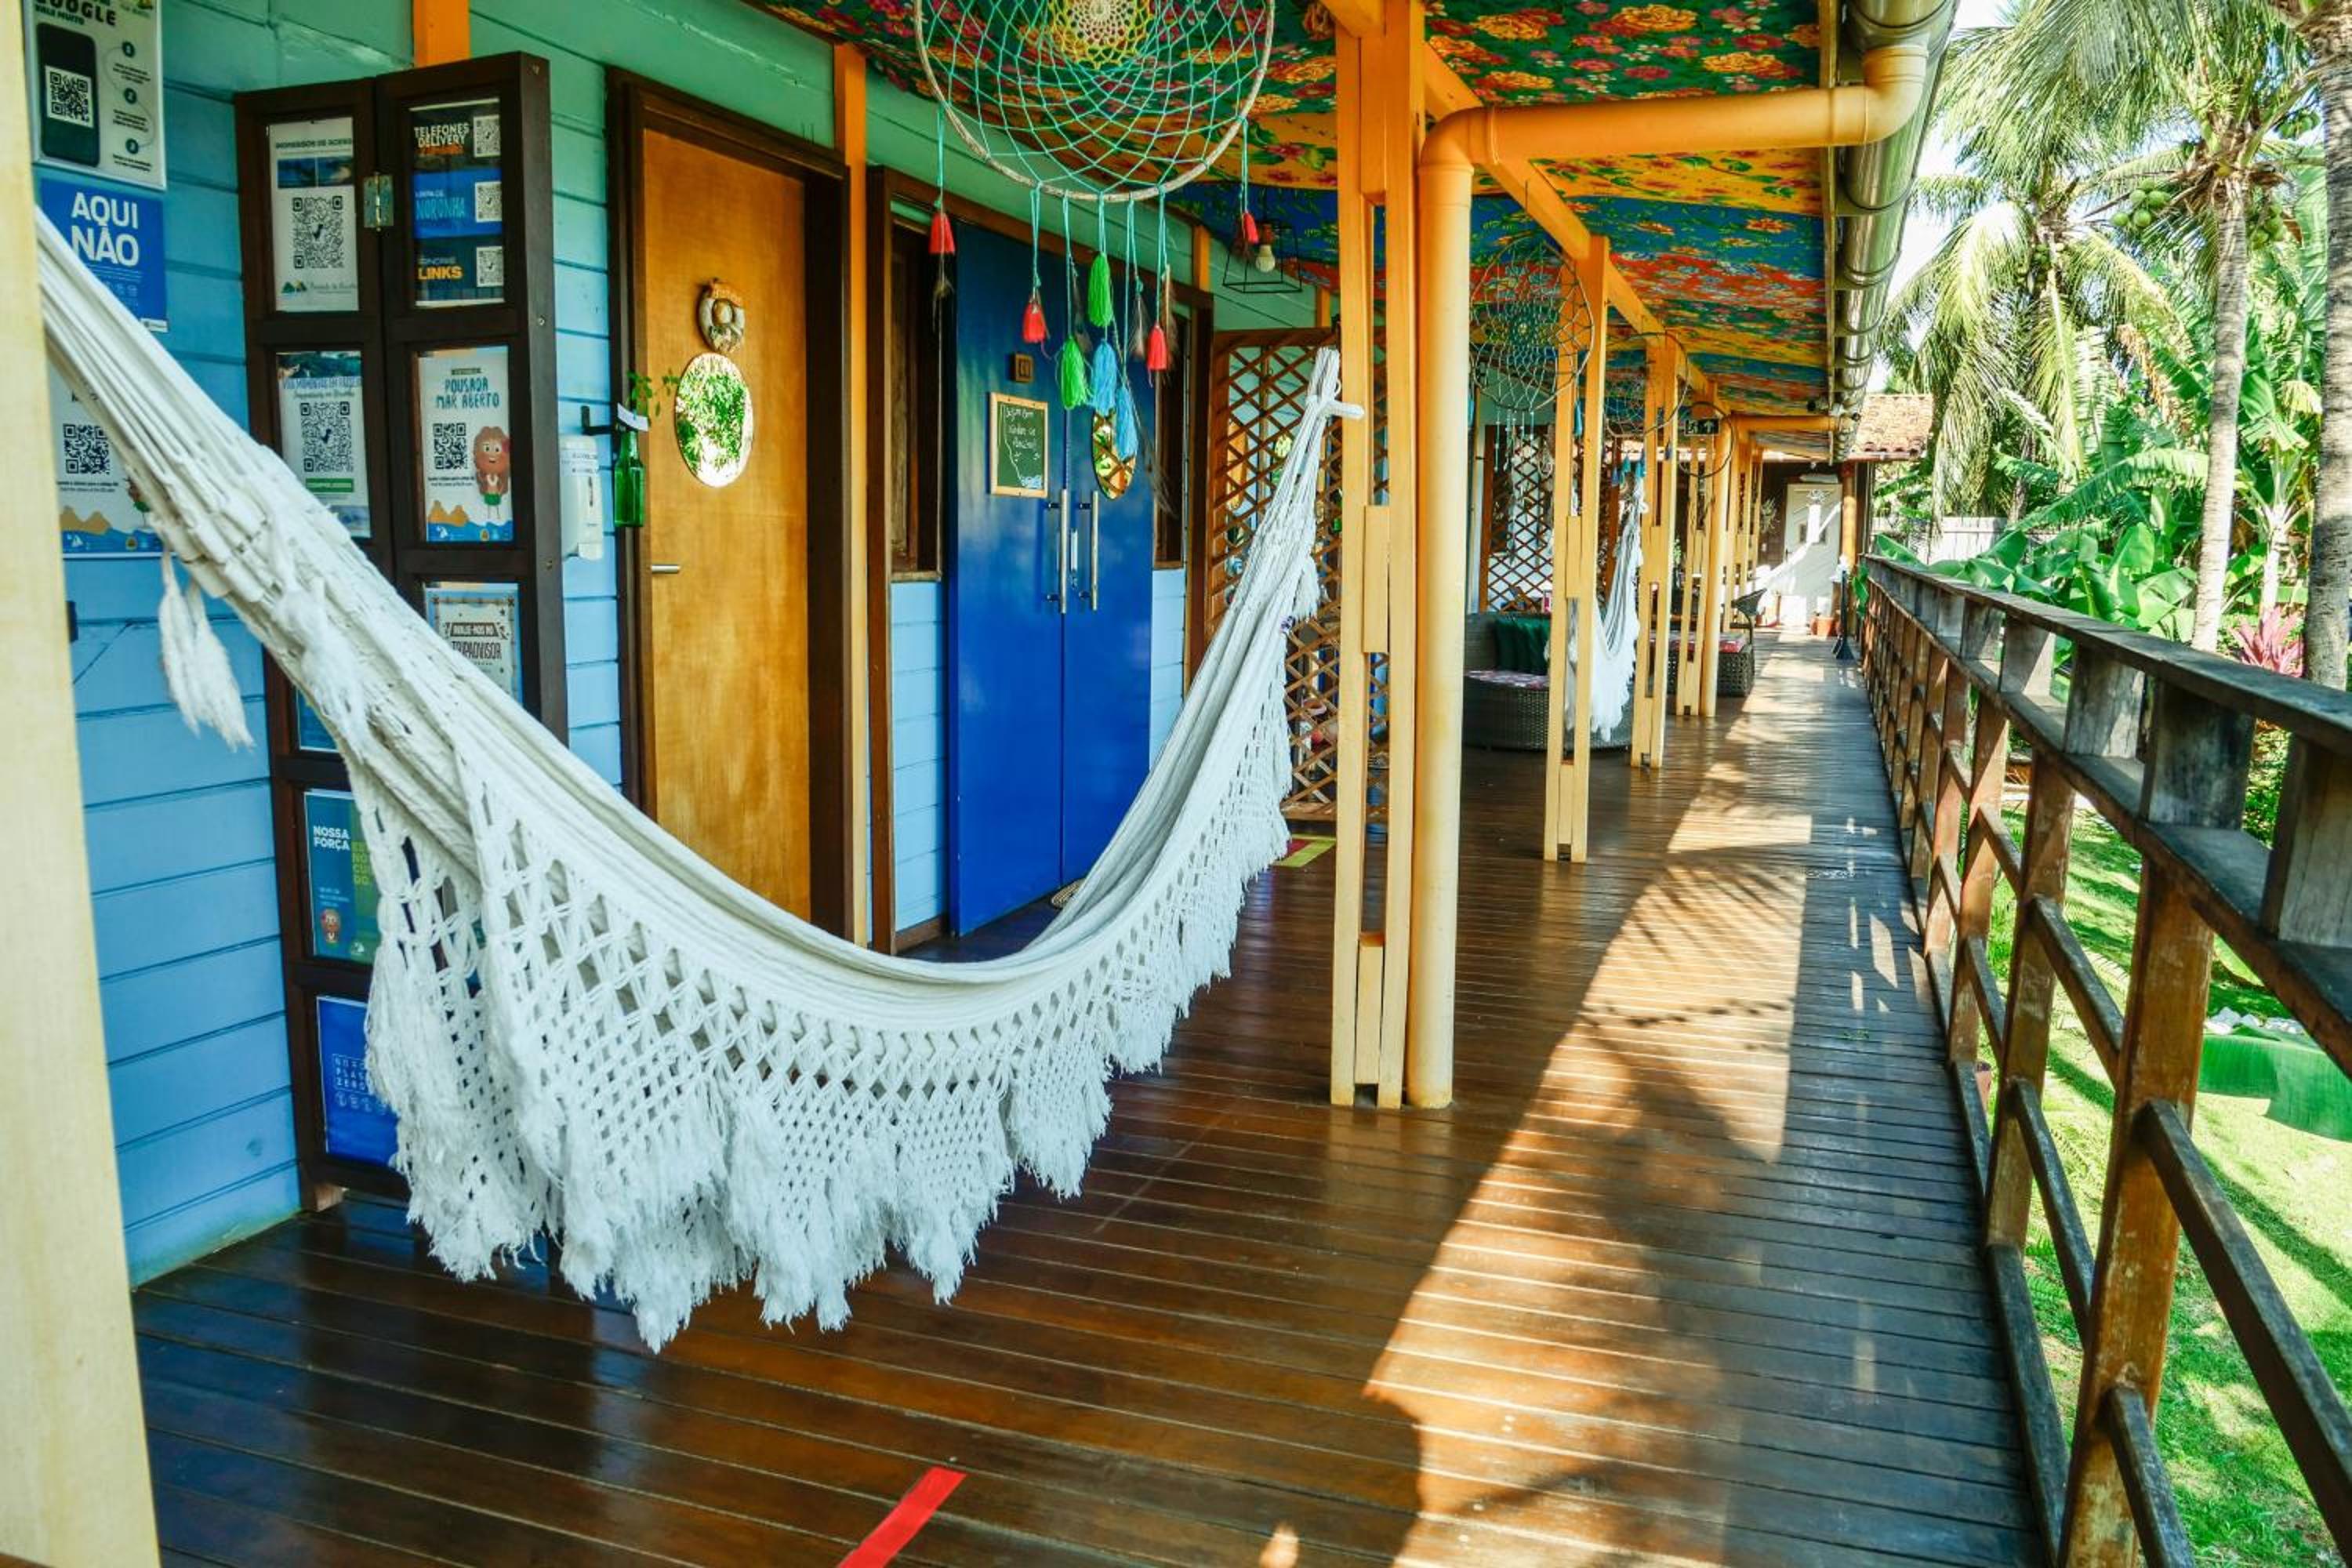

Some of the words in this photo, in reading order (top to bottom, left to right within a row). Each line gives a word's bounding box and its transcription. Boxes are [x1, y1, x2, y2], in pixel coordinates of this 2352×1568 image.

[34, 0, 117, 27] OOGLE
[413, 122, 470, 139] TELEFONES
[418, 133, 465, 148] DELIVERY
[71, 192, 138, 230] AQUI
[418, 266, 463, 281] LINKS
[445, 376, 488, 393] POUSADA
[462, 392, 500, 408] ABERTO
[314, 825, 350, 840] NOSSA
[314, 837, 351, 851] FORÇA
